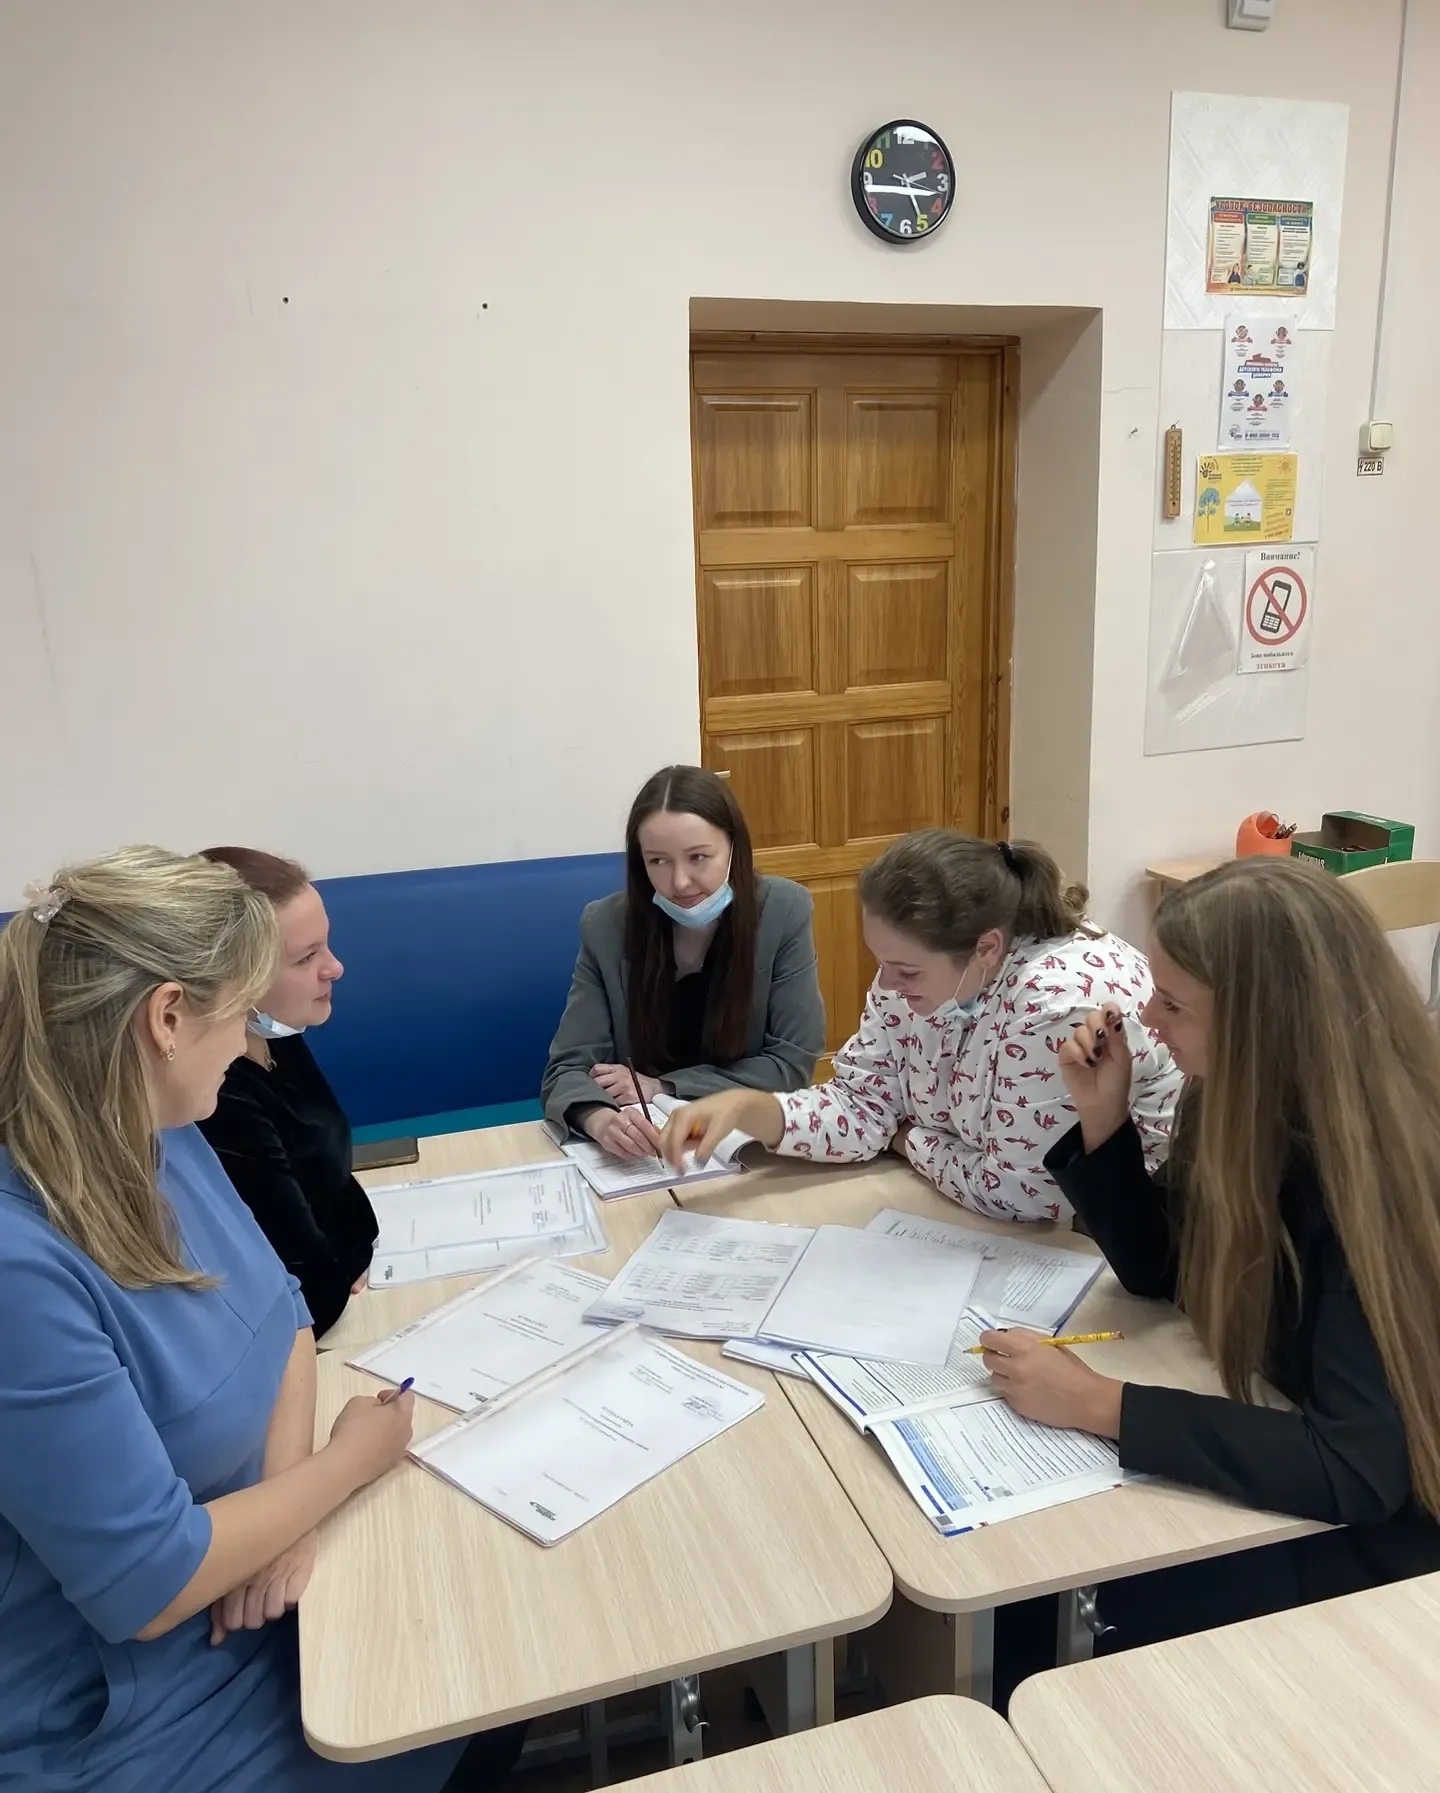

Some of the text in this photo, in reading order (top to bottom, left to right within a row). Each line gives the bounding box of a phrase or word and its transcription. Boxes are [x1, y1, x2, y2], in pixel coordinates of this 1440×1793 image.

[864, 149, 883, 168] 10
[931, 151, 944, 170] 2
[936, 173, 949, 192] 3
[931, 197, 943, 213] 4
[880, 213, 894, 226] 7
[899, 219, 912, 235] 6
[916, 214, 929, 231] 5
[1364, 460, 1376, 472] 220
[1260, 552, 1301, 561] Внимание!
